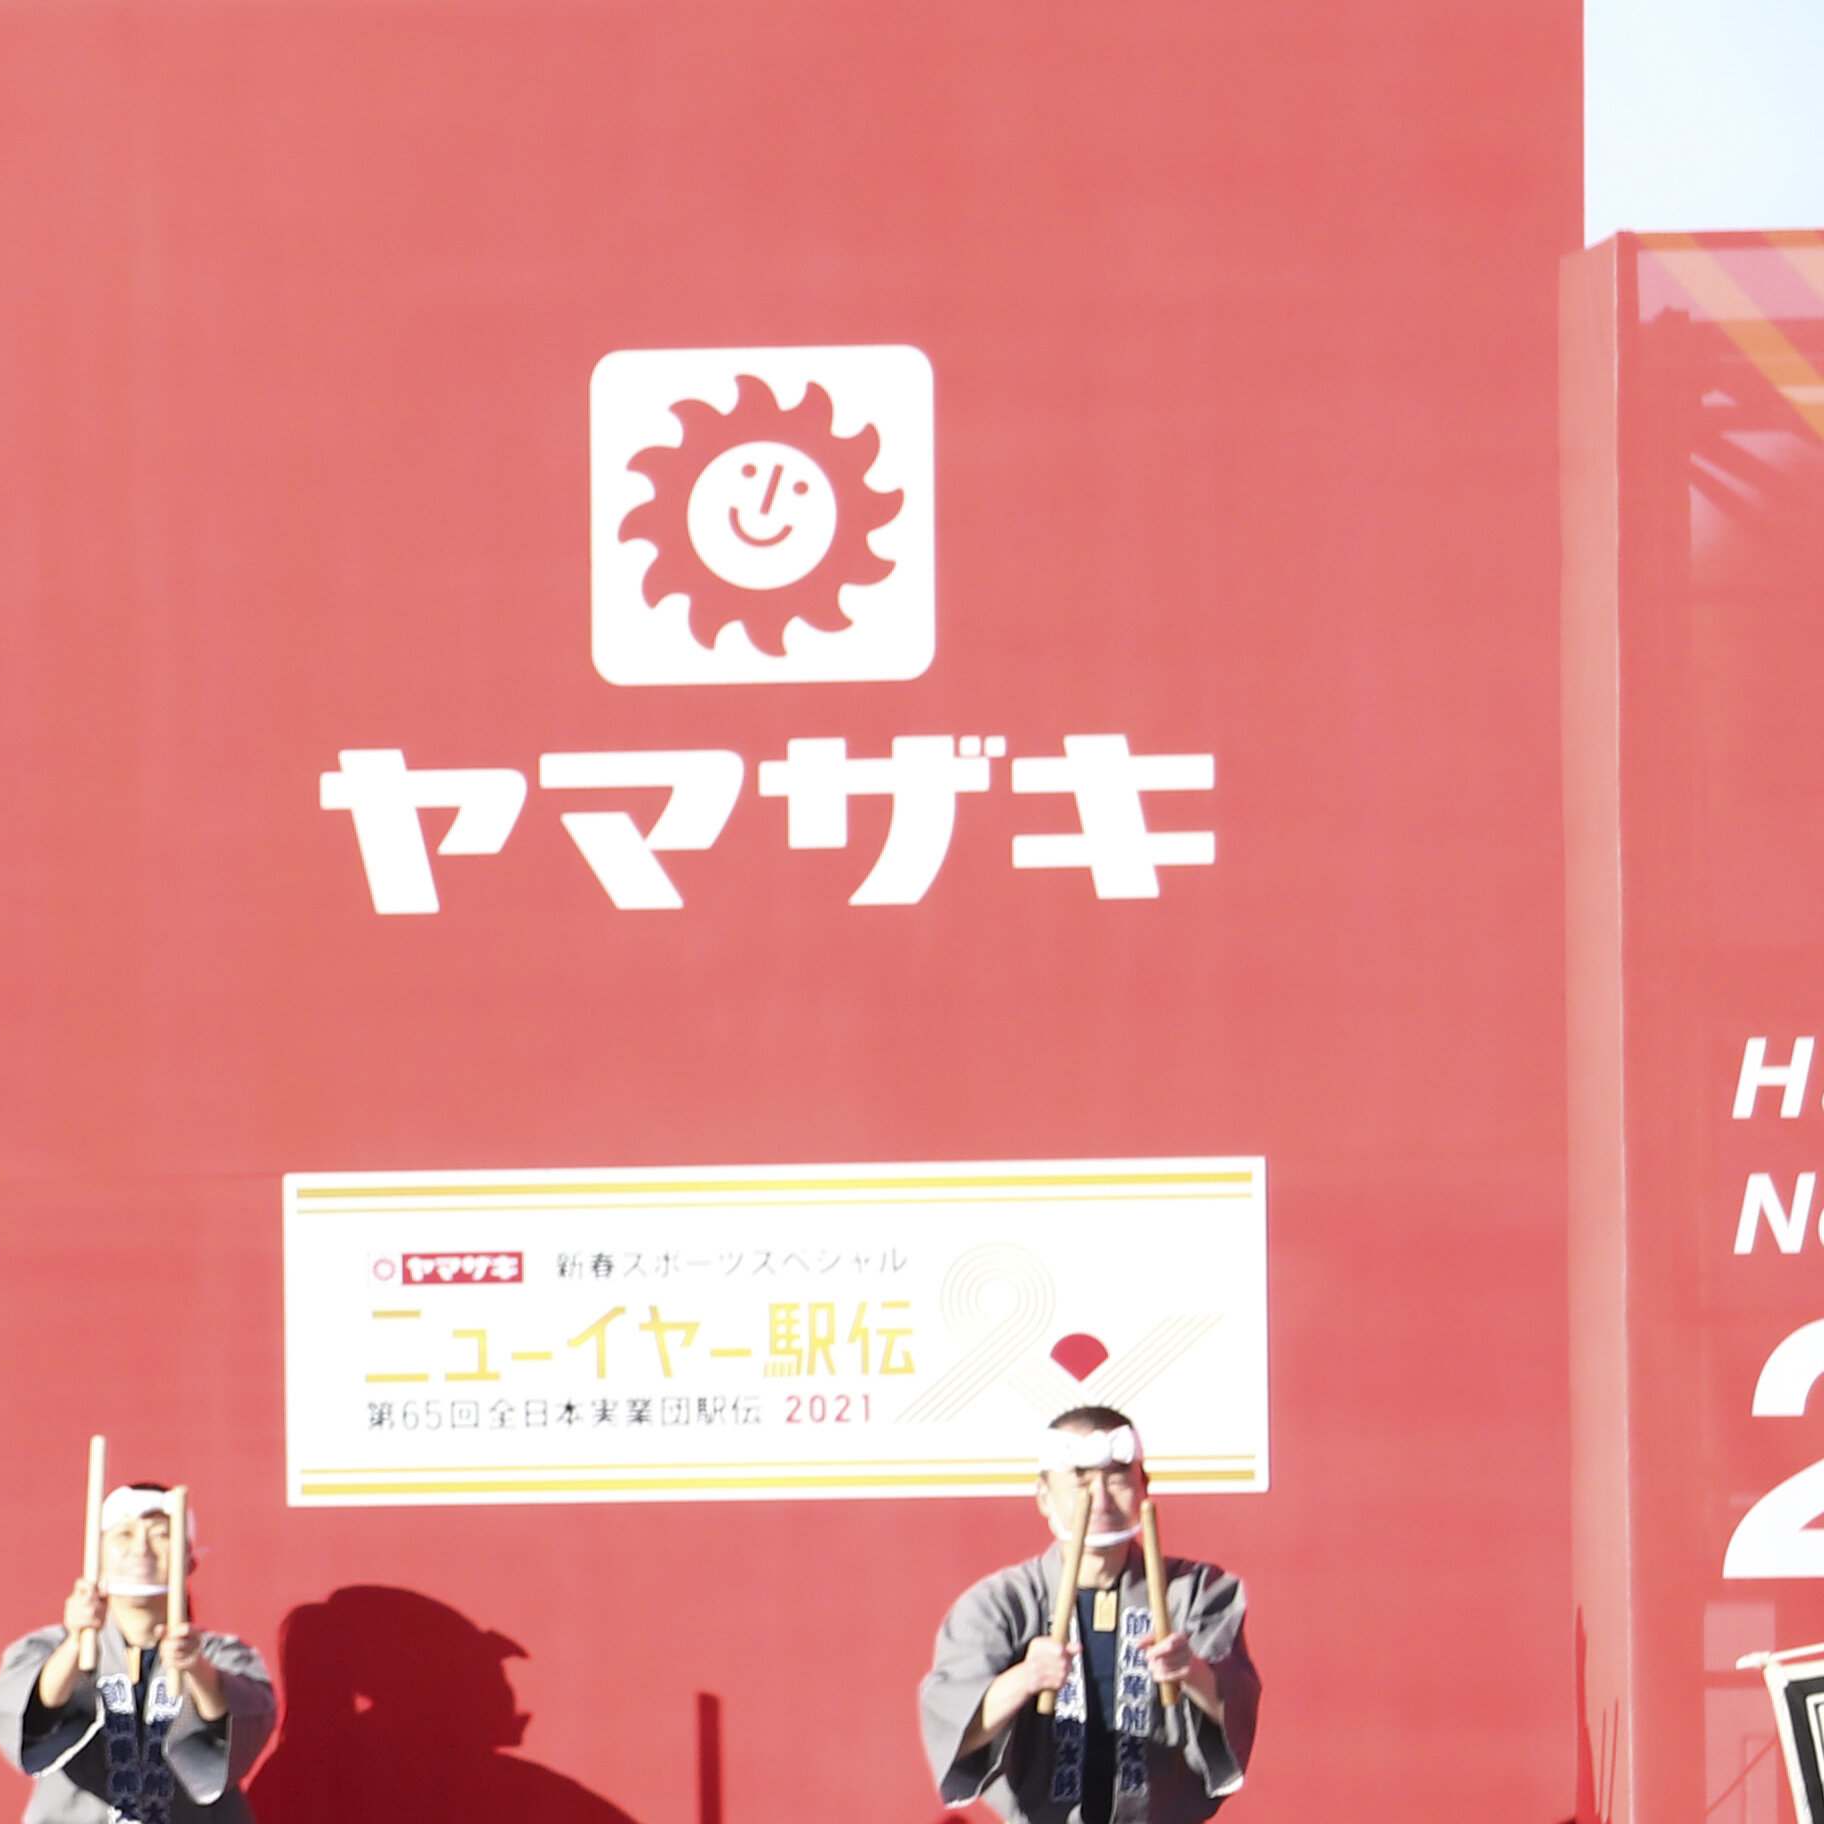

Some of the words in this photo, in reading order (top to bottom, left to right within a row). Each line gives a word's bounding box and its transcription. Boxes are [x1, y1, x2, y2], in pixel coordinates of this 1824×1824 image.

[319, 733, 1215, 914] ヤマザキ
[403, 1253, 522, 1282] ヤマザキ
[557, 1247, 908, 1282] 新春スポーツスペシャル
[364, 1300, 916, 1384] ニューイヤー駅伝
[367, 1395, 763, 1432] 第65回全日本実業団駅伝
[785, 1394, 874, 1425] 2021
